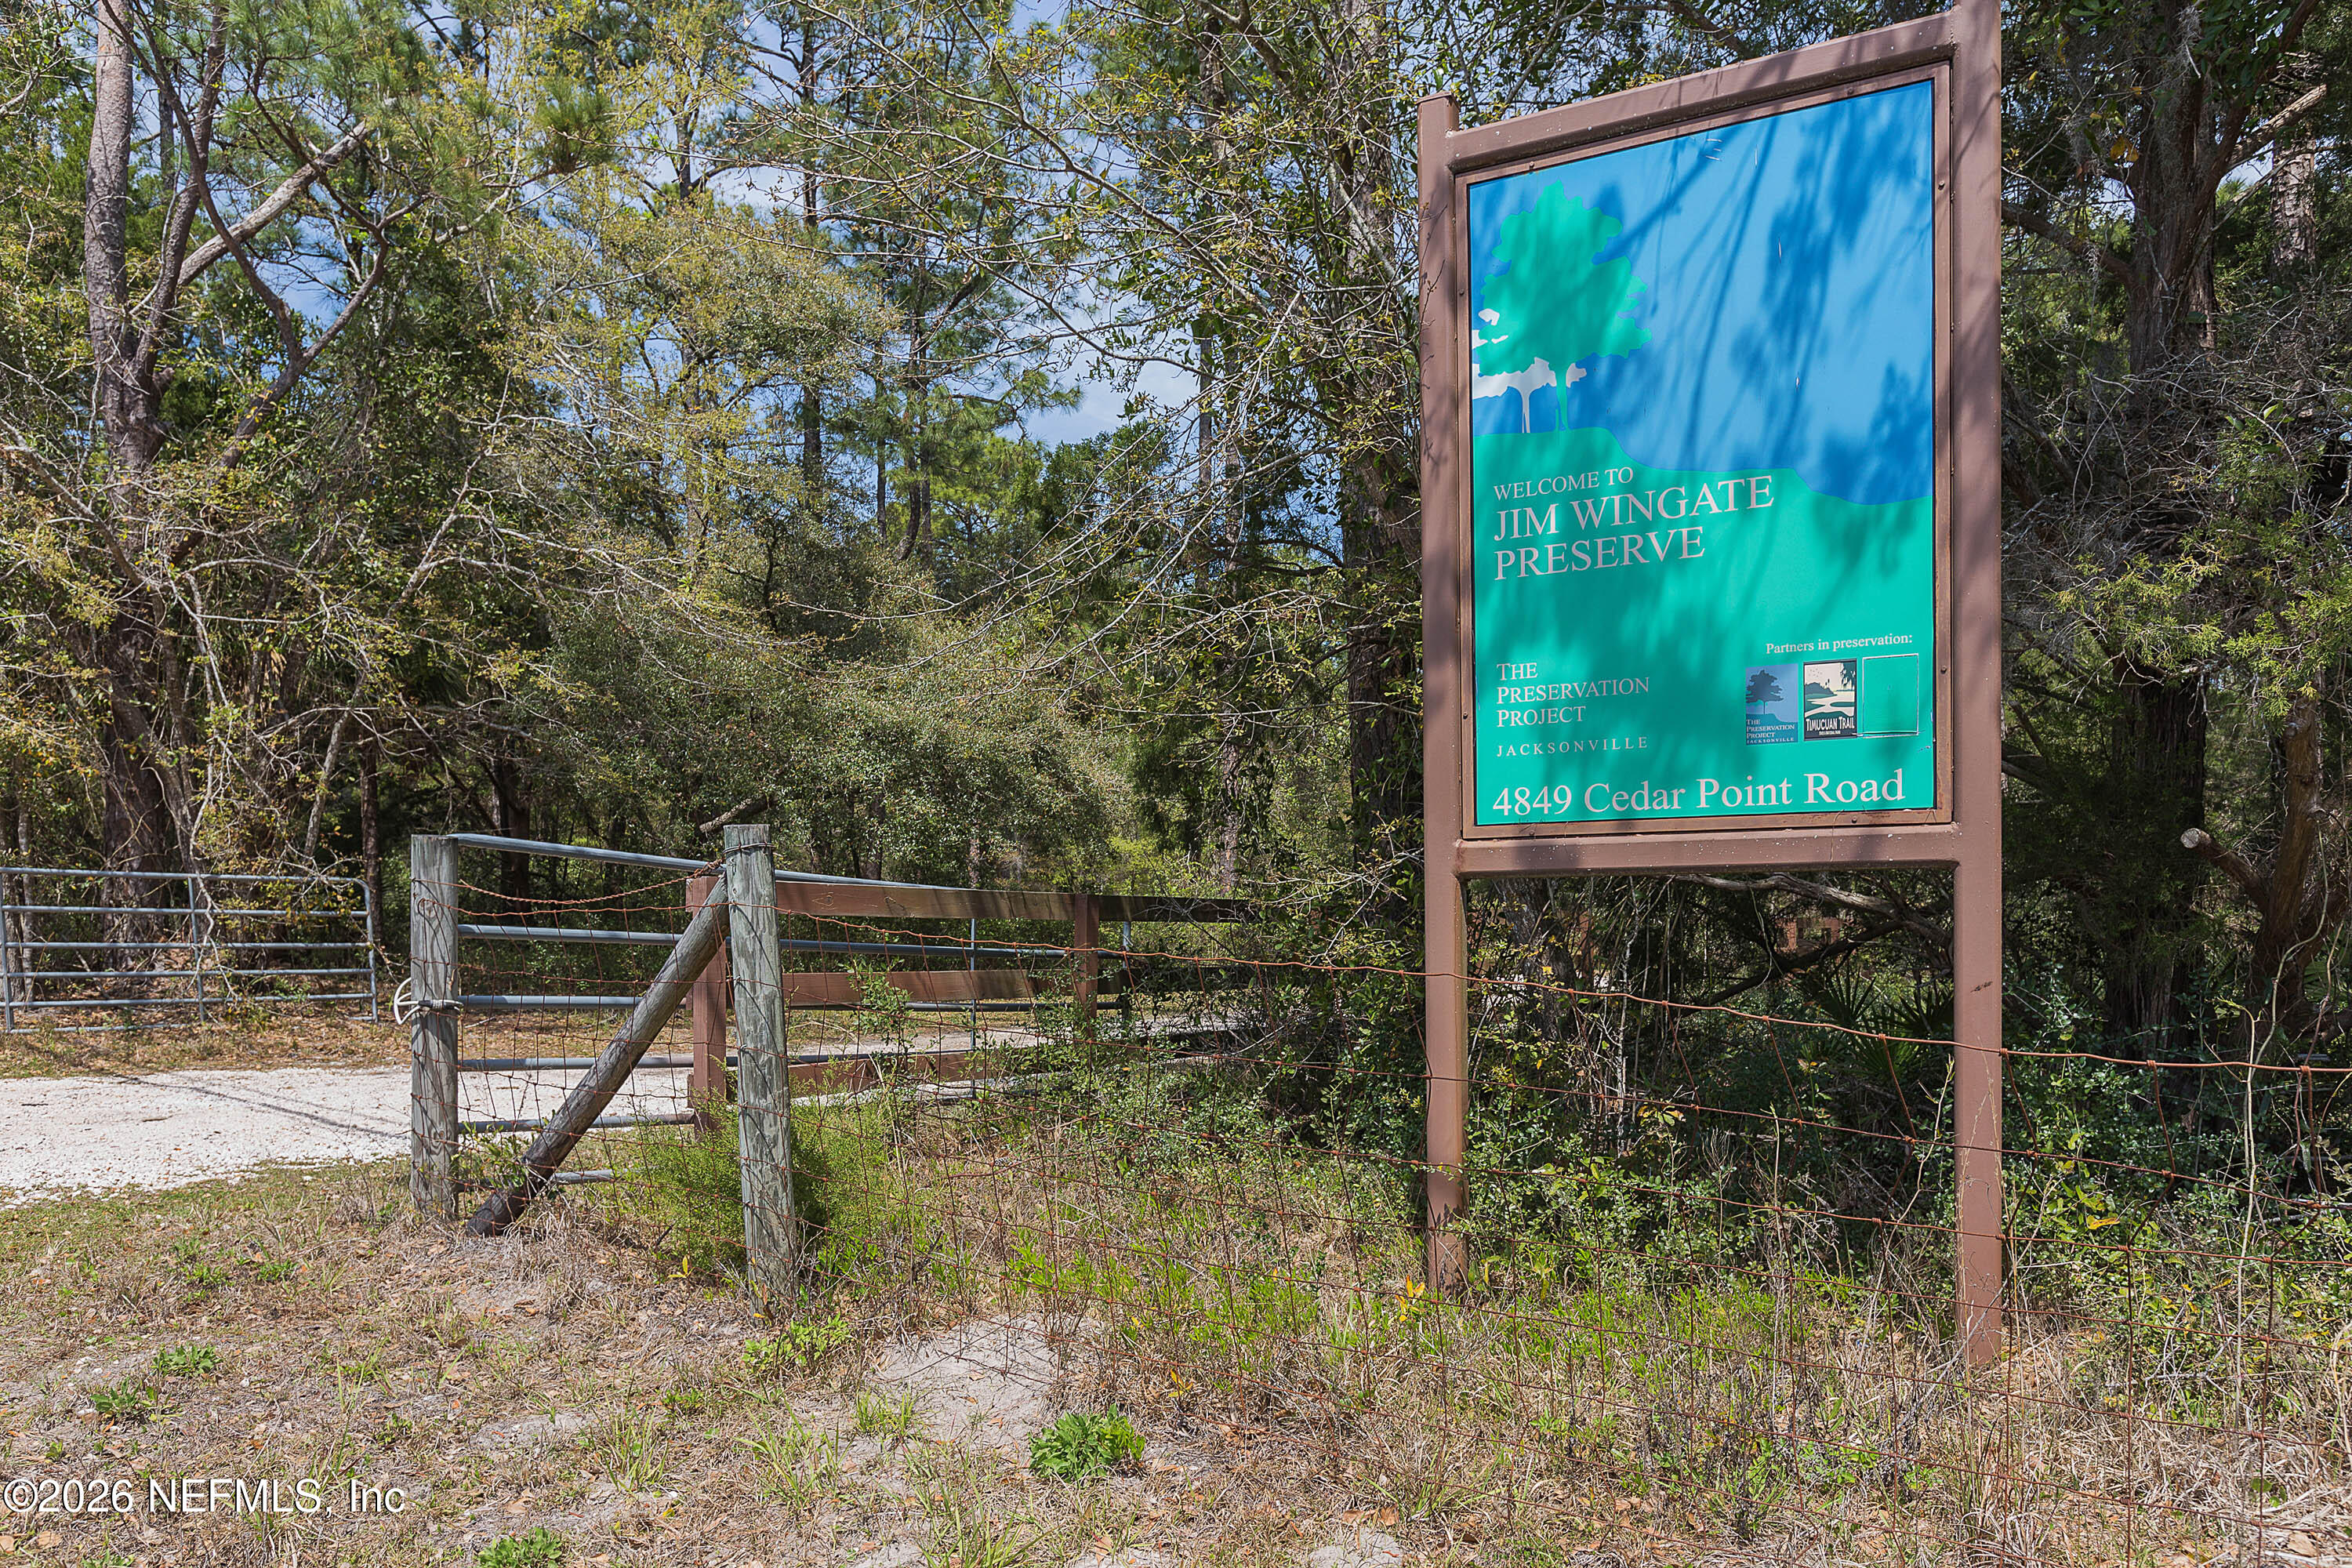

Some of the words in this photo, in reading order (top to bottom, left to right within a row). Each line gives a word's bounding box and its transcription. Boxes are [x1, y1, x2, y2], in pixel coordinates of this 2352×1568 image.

[1494, 471, 1599, 500] WELCOME
[1605, 466, 1633, 485] TO
[1494, 503, 1559, 541] JIM
[1570, 475, 1774, 530] WINGATE
[1494, 526, 1705, 580] PRESERVE
[1766, 642, 1814, 654] Partners
[1818, 639, 1829, 650] in
[1833, 633, 1912, 652] preservation:
[1497, 662, 1537, 681] THE
[1497, 677, 1650, 704] PRESERVATION
[1497, 706, 1586, 727] PROJECT
[1806, 718, 1838, 731] TIMUCUAN
[1838, 717, 1855, 729] TRAIL
[1497, 737, 1647, 757] JACKSONVILLE
[1493, 785, 1572, 816] 4849
[1584, 781, 1686, 813] Cedar
[1696, 775, 1793, 808] Point
[1804, 768, 1905, 804] Road
